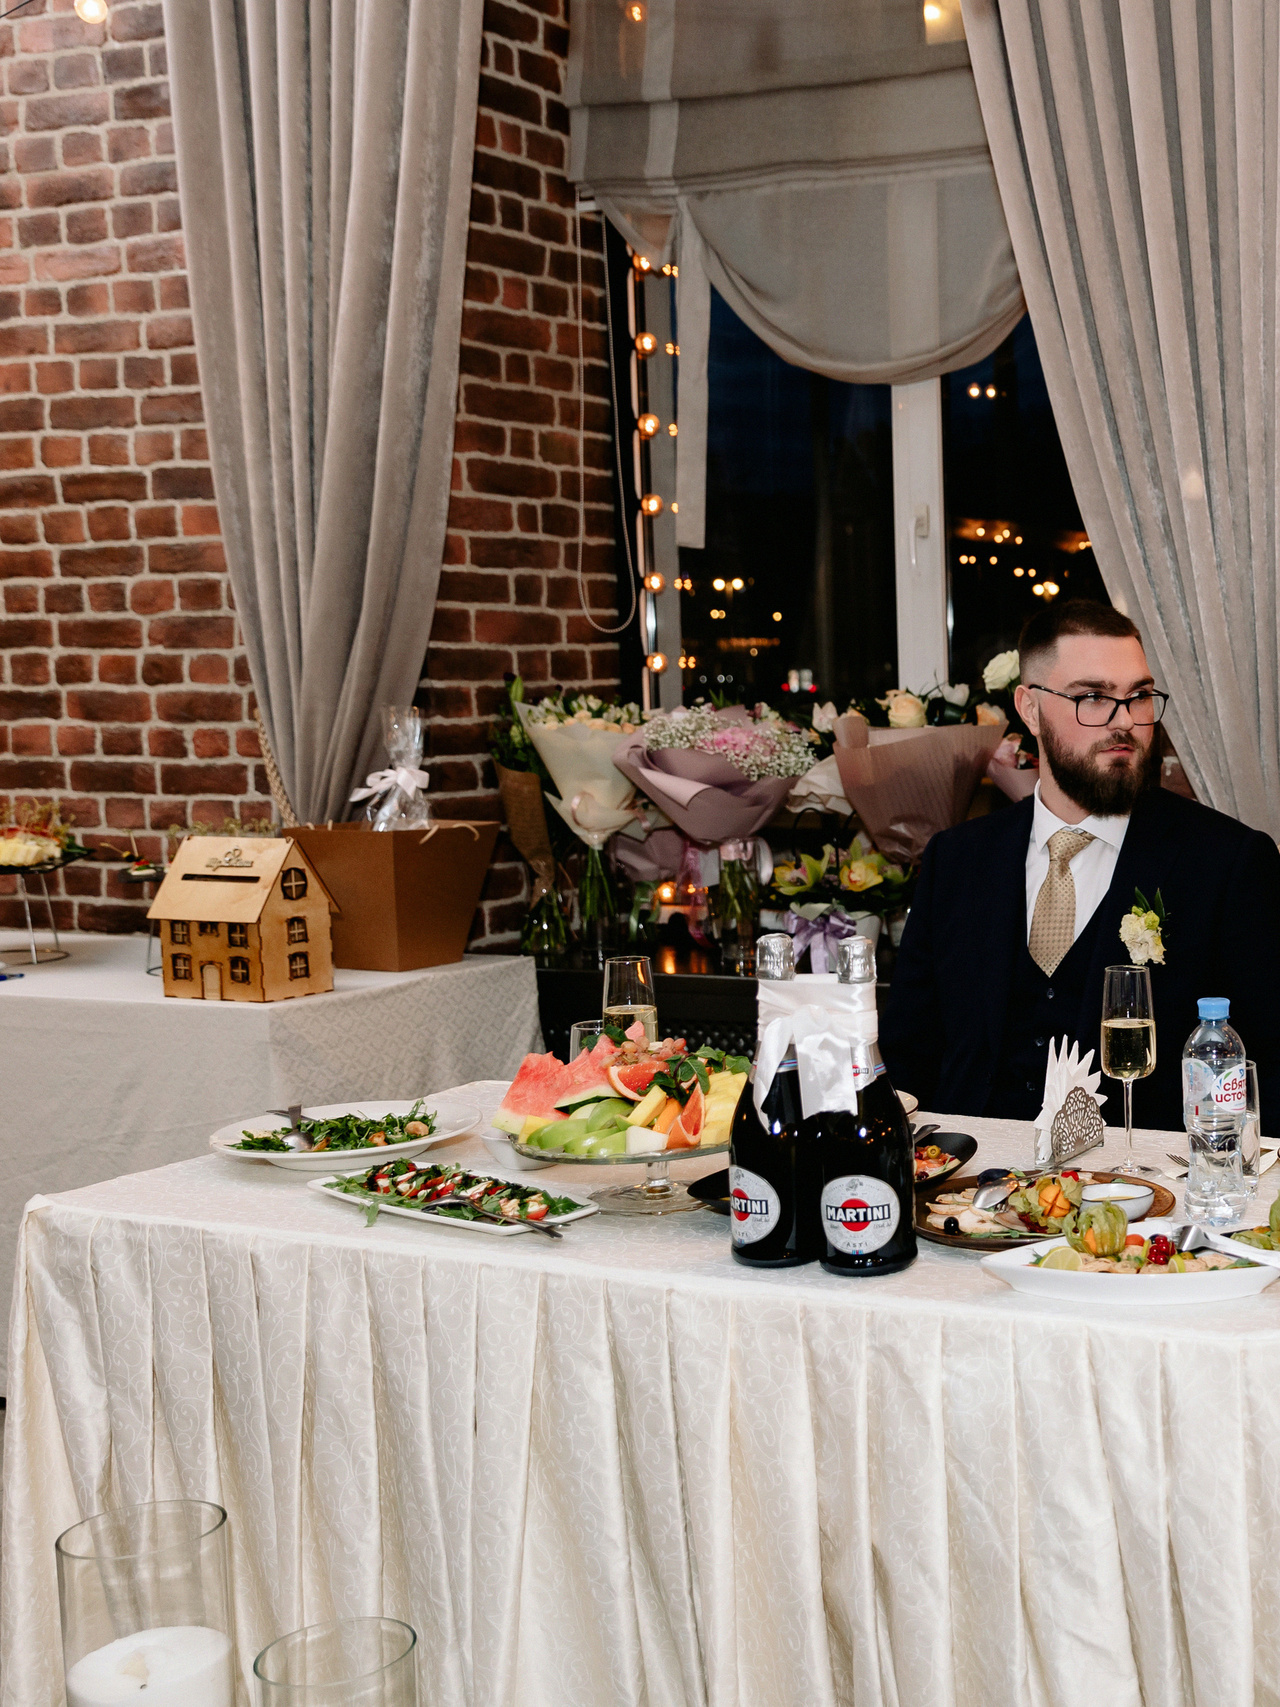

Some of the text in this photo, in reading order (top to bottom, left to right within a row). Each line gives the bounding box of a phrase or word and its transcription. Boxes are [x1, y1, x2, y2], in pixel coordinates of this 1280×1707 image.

[1223, 1078, 1246, 1091] СВЯТ
[1215, 1090, 1246, 1103] ИСТОЧ
[731, 1195, 767, 1214] ARTINI
[827, 1205, 889, 1222] MARTINI
